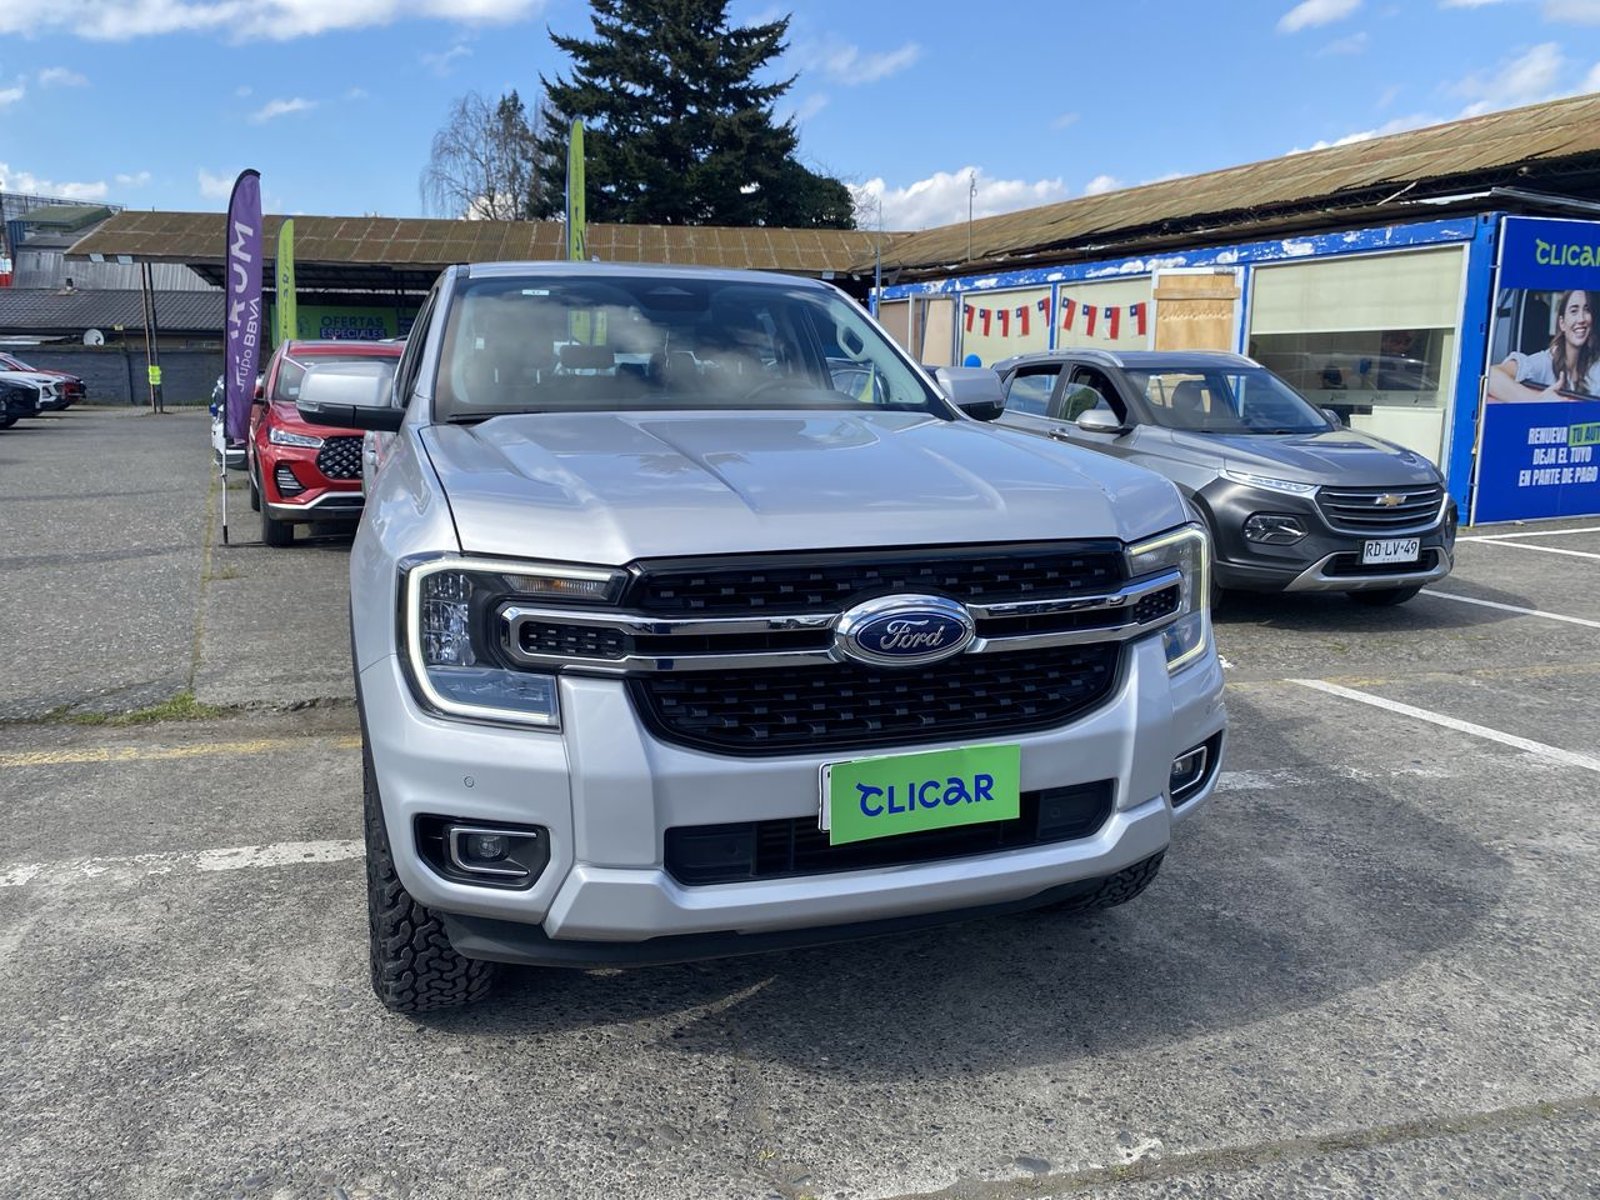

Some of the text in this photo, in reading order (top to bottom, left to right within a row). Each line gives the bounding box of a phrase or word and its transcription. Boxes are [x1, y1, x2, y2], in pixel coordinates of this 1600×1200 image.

[243, 297, 260, 347] BBVA
[321, 315, 384, 328] OFERTAS
[321, 328, 385, 339] ESPECIALES
[1528, 427, 1568, 445] RENUEVA
[1572, 426, 1583, 444] TU
[1532, 446, 1592, 465] DEJA EL TUYO
[1518, 466, 1598, 487] EN PARTE DE PAGO
[880, 619, 946, 650] Ford
